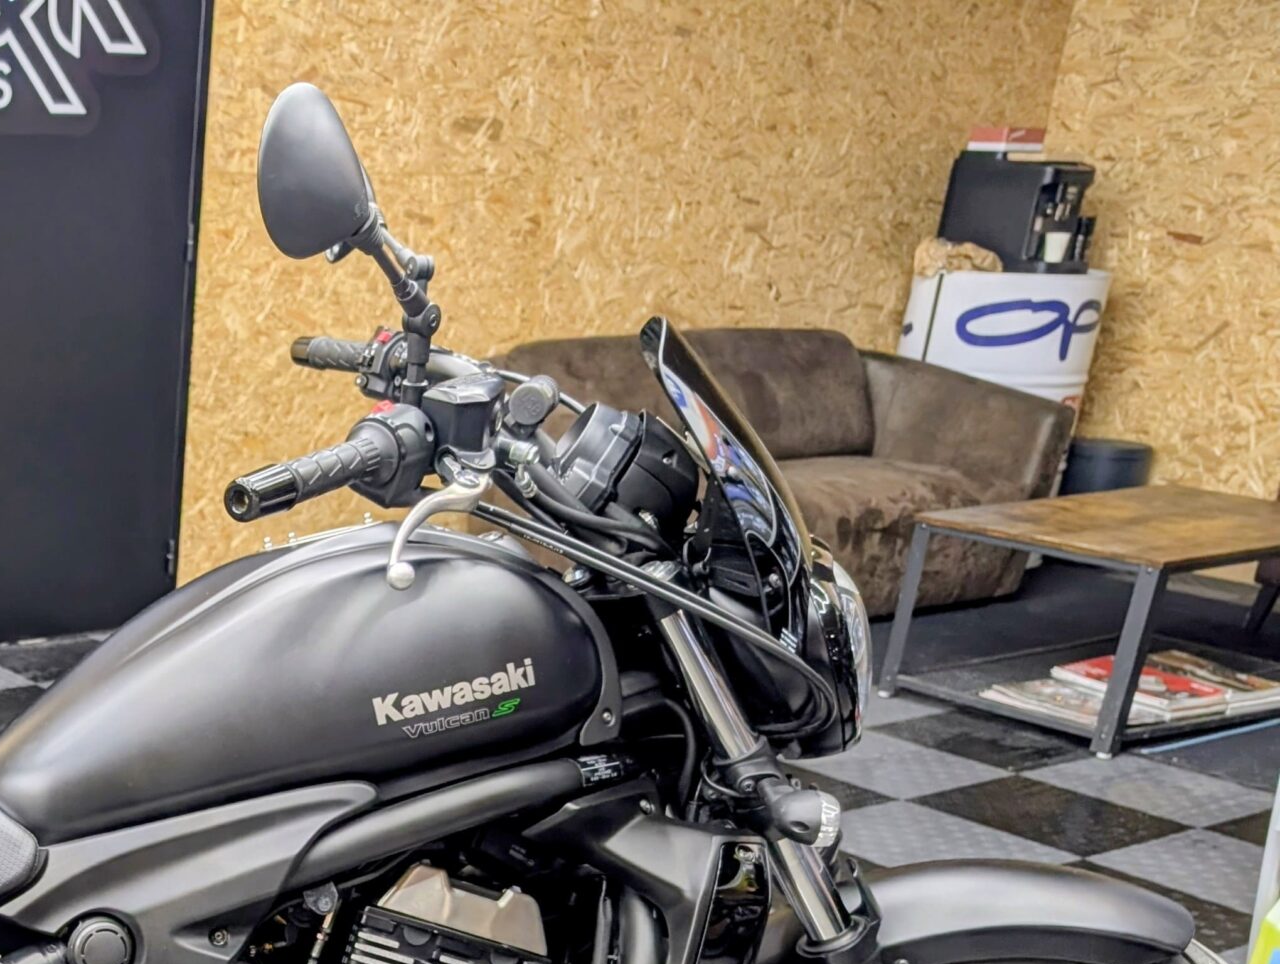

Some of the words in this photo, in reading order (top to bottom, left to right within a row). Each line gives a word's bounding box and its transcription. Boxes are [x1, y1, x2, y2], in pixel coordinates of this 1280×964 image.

[372, 657, 536, 726] Kawasaki
[402, 708, 490, 739] Vulcan
[491, 698, 520, 718] S
